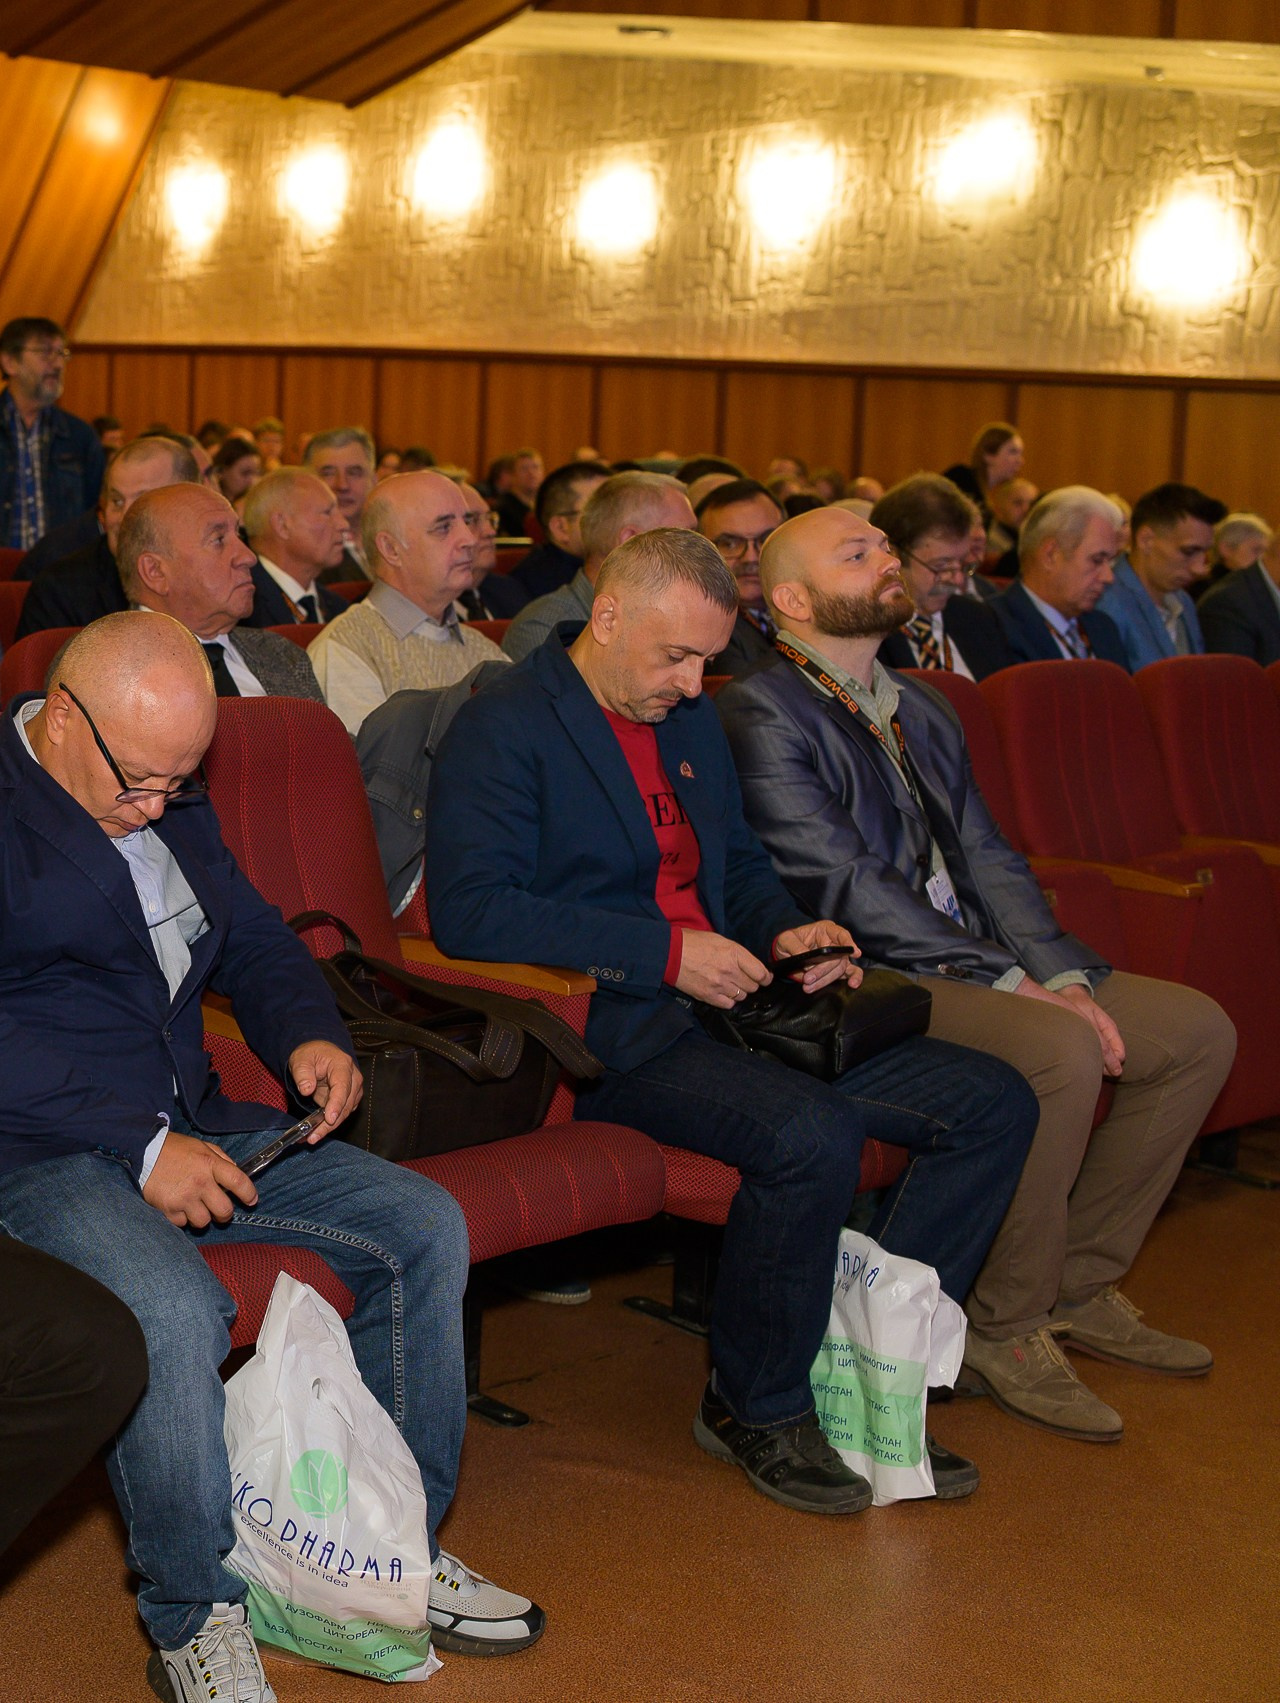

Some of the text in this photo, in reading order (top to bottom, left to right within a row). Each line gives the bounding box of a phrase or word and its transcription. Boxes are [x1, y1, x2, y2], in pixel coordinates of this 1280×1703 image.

[819, 673, 859, 714] BOWA
[241, 1516, 293, 1561] excellence
[296, 1558, 305, 1568] is
[308, 1564, 319, 1576] in
[322, 1573, 349, 1588] idea
[285, 1603, 346, 1631] ДУЗОФАРМ
[323, 1626, 383, 1641] ЦИТОРЕАН
[264, 1620, 343, 1654] ВАЗАПРОСТАН
